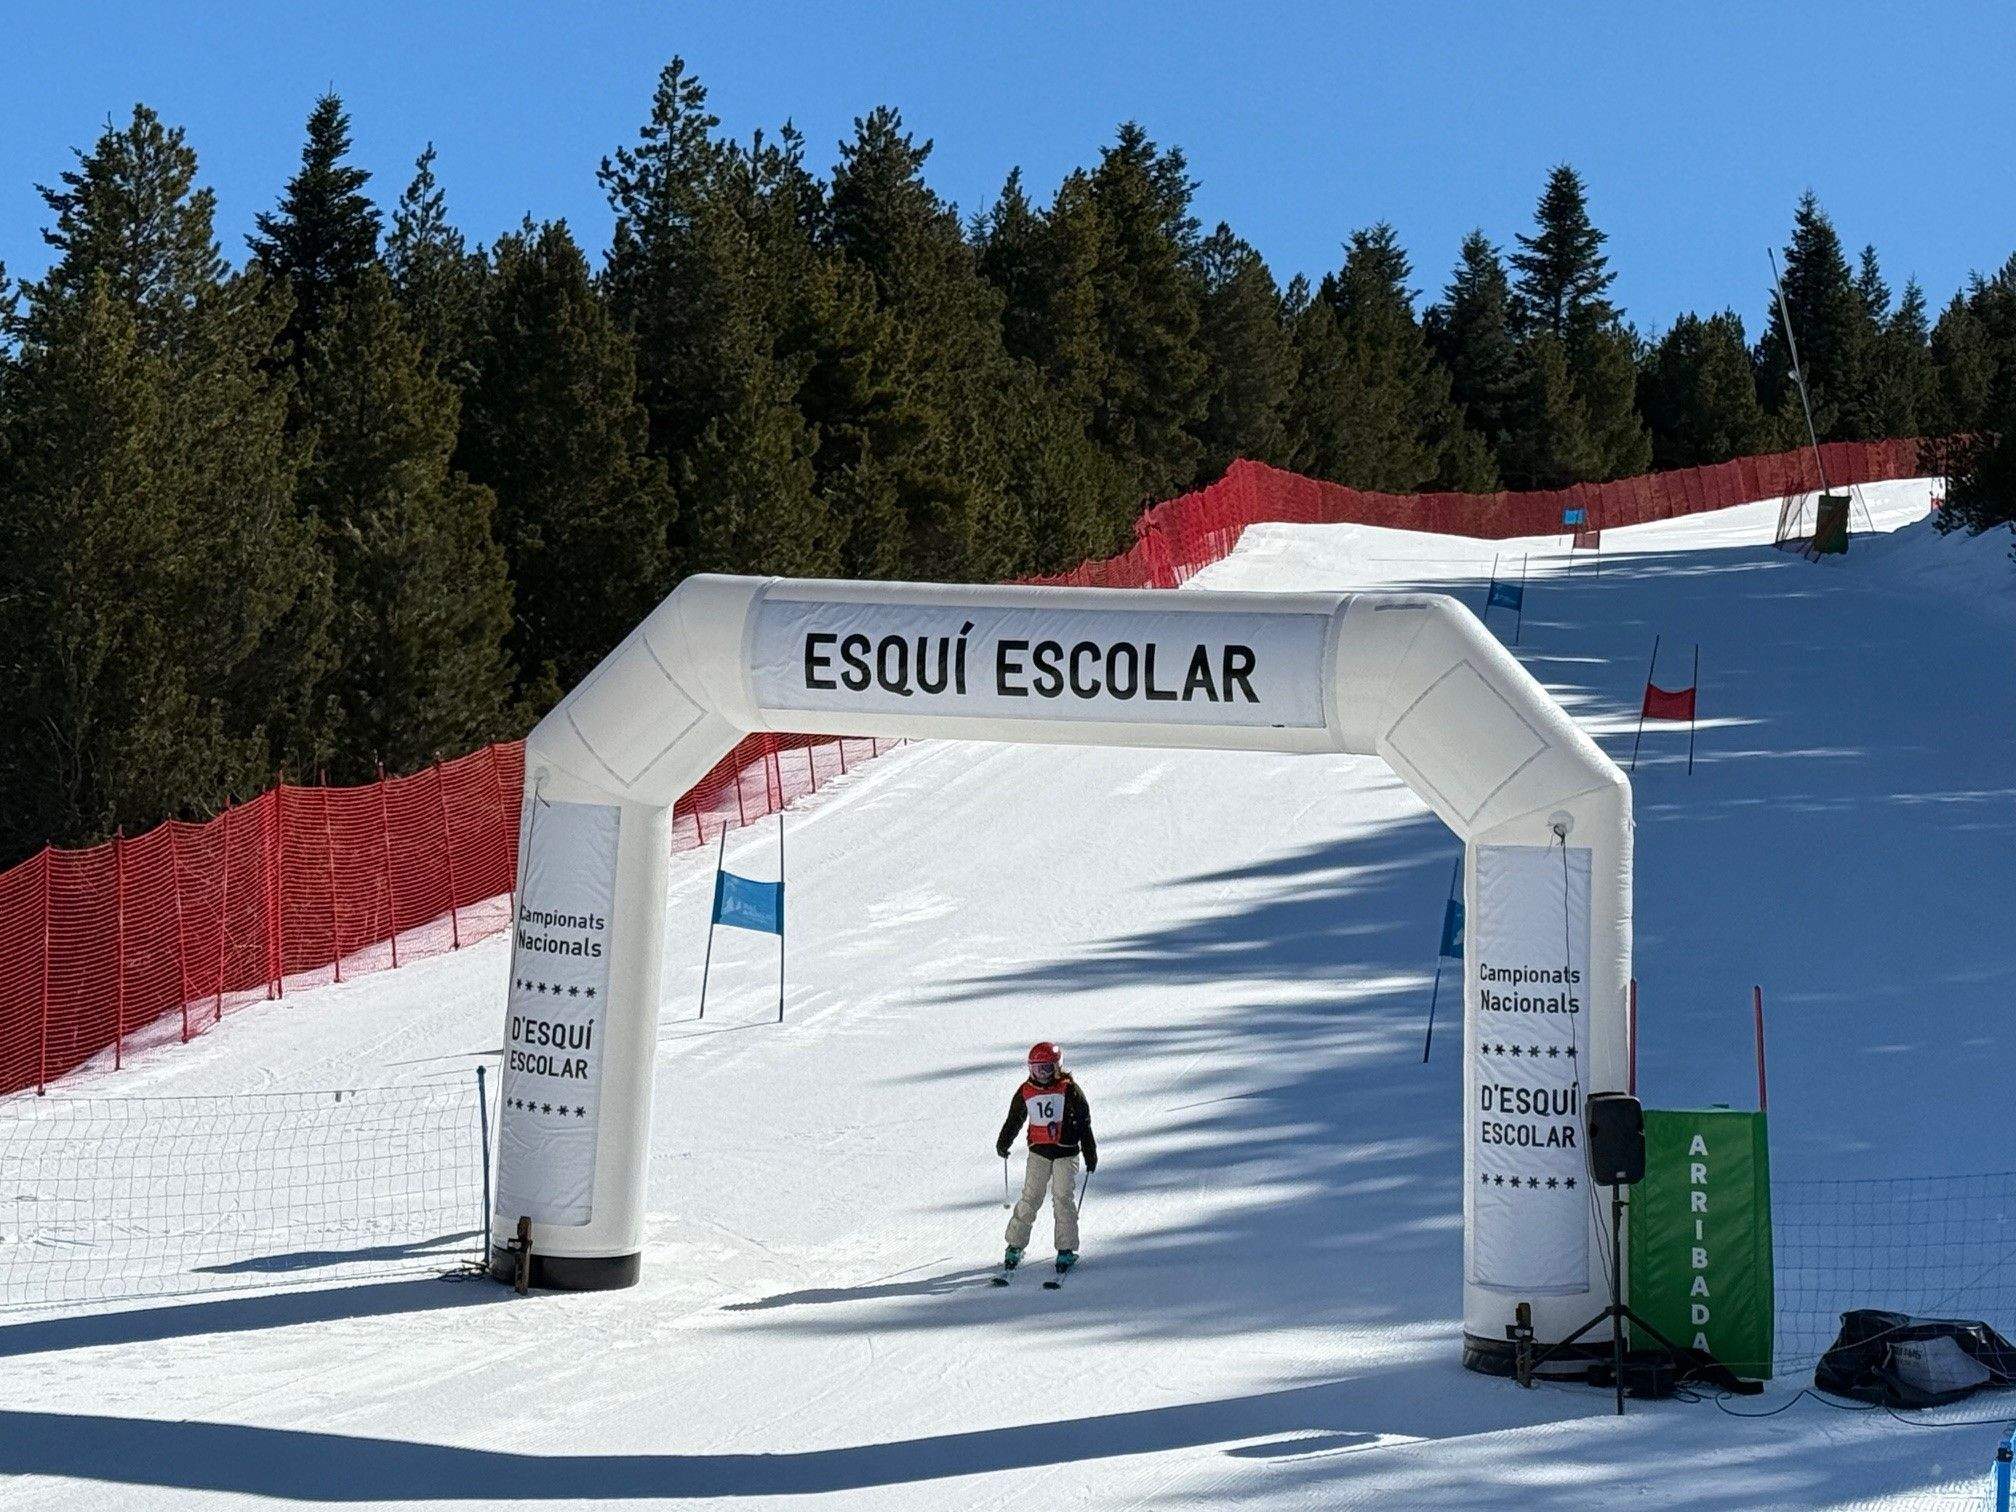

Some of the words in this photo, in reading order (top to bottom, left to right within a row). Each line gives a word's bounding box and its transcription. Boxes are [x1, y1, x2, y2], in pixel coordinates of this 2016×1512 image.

[804, 621, 974, 697] ESQUÍ
[996, 639, 1260, 703] ESCOLAR
[520, 905, 604, 930] Campionats
[518, 929, 602, 957] Nacionals
[1480, 963, 1580, 986] Campionats
[1481, 989, 1579, 1013] Nacionals
[512, 1015, 595, 1050] D'ESQUÍ
[510, 1050, 588, 1079] ESCOLAR
[1036, 1101, 1054, 1118] 16
[1481, 1082, 1578, 1116] D'ESQUÍ
[1482, 1121, 1577, 1148] ESCOLAR
[1688, 1135, 1711, 1354] ARRIBADA
